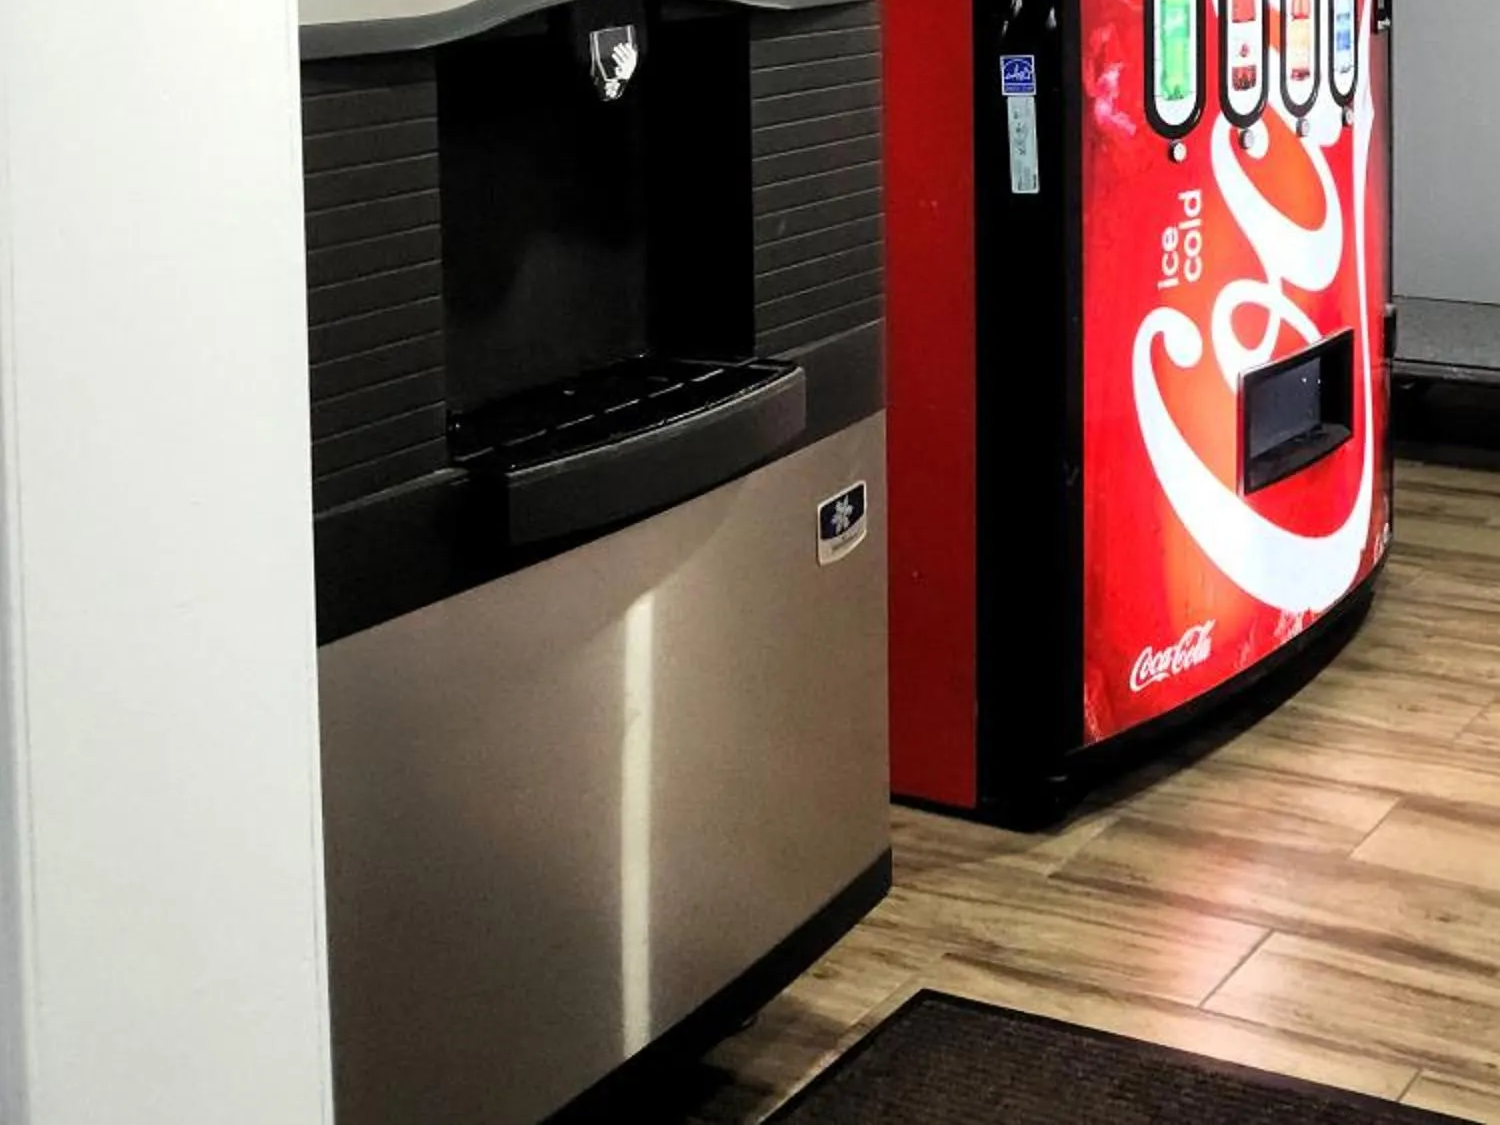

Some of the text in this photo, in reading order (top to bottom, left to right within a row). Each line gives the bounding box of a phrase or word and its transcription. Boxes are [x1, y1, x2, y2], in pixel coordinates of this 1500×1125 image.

[1157, 226, 1179, 289] ice
[1178, 188, 1203, 282] cold
[1128, 619, 1216, 692] Coca-Cola
